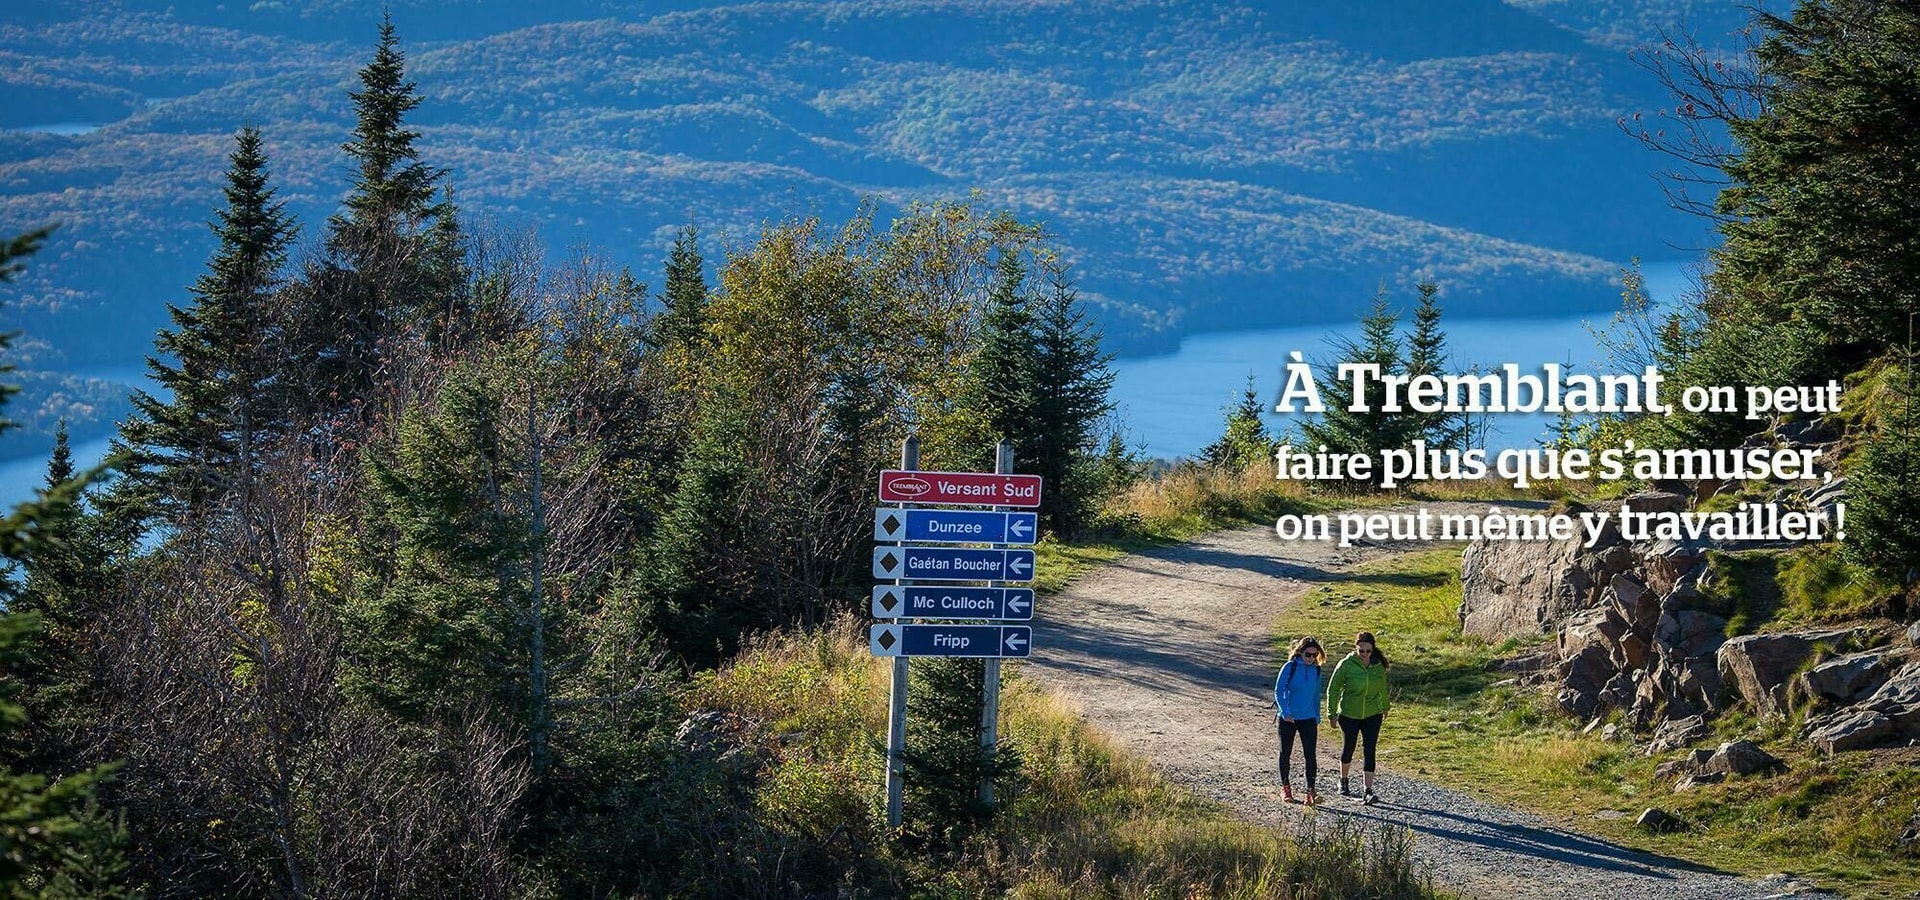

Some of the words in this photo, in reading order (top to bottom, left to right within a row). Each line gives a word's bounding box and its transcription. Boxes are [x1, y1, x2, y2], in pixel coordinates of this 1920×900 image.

[937, 480, 997, 497] Versant
[1003, 483, 1034, 498] Sud
[928, 519, 983, 534] Dunzee
[908, 556, 950, 571] Gaétan
[953, 557, 1002, 572] Boucher
[913, 595, 936, 609] Mc
[941, 596, 995, 610] Culloch
[933, 633, 970, 648] Fripp
